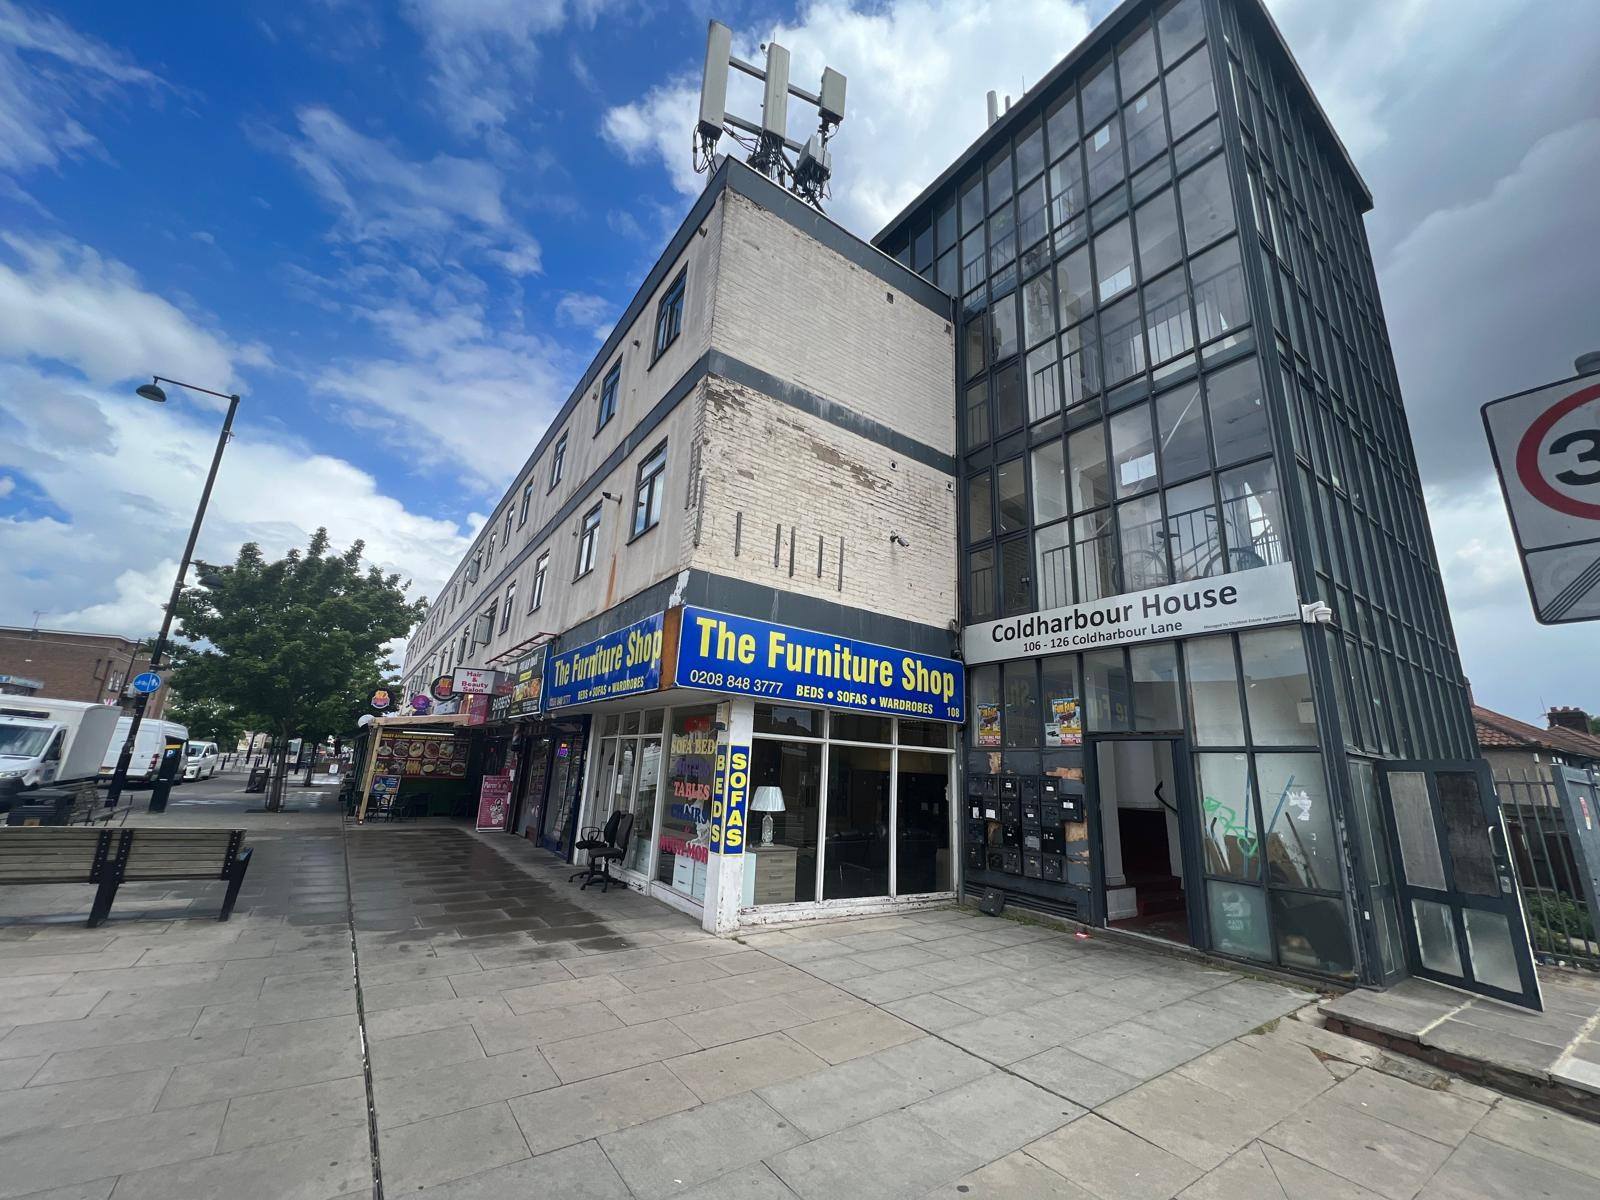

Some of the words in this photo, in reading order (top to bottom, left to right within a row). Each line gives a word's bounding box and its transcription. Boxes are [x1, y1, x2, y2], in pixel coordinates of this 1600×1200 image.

[992, 604, 1133, 643] Coldharbour
[1142, 585, 1237, 619] House
[1023, 641, 1041, 653] 106
[1051, 637, 1070, 649] 126
[1072, 626, 1148, 646] Coldharbour
[1151, 621, 1183, 635] Lane
[554, 660, 570, 687] The
[571, 643, 623, 683] Furniture
[626, 629, 663, 669] Shop
[696, 616, 756, 664] The
[767, 631, 893, 687] Furniture
[901, 656, 955, 704] Shop
[461, 680, 488, 688] Beauty
[689, 669, 723, 686] 0208
[726, 675, 750, 690] 848
[753, 679, 783, 695] 3777
[796, 684, 824, 699] BEDS
[836, 690, 868, 705] SOFAS
[879, 696, 933, 715] WARDROBES
[946, 706, 960, 718] 108
[692, 738, 717, 755] BED
[673, 781, 710, 800] TABLES
[711, 754, 726, 843] BEDS
[726, 753, 747, 847] SOFAS
